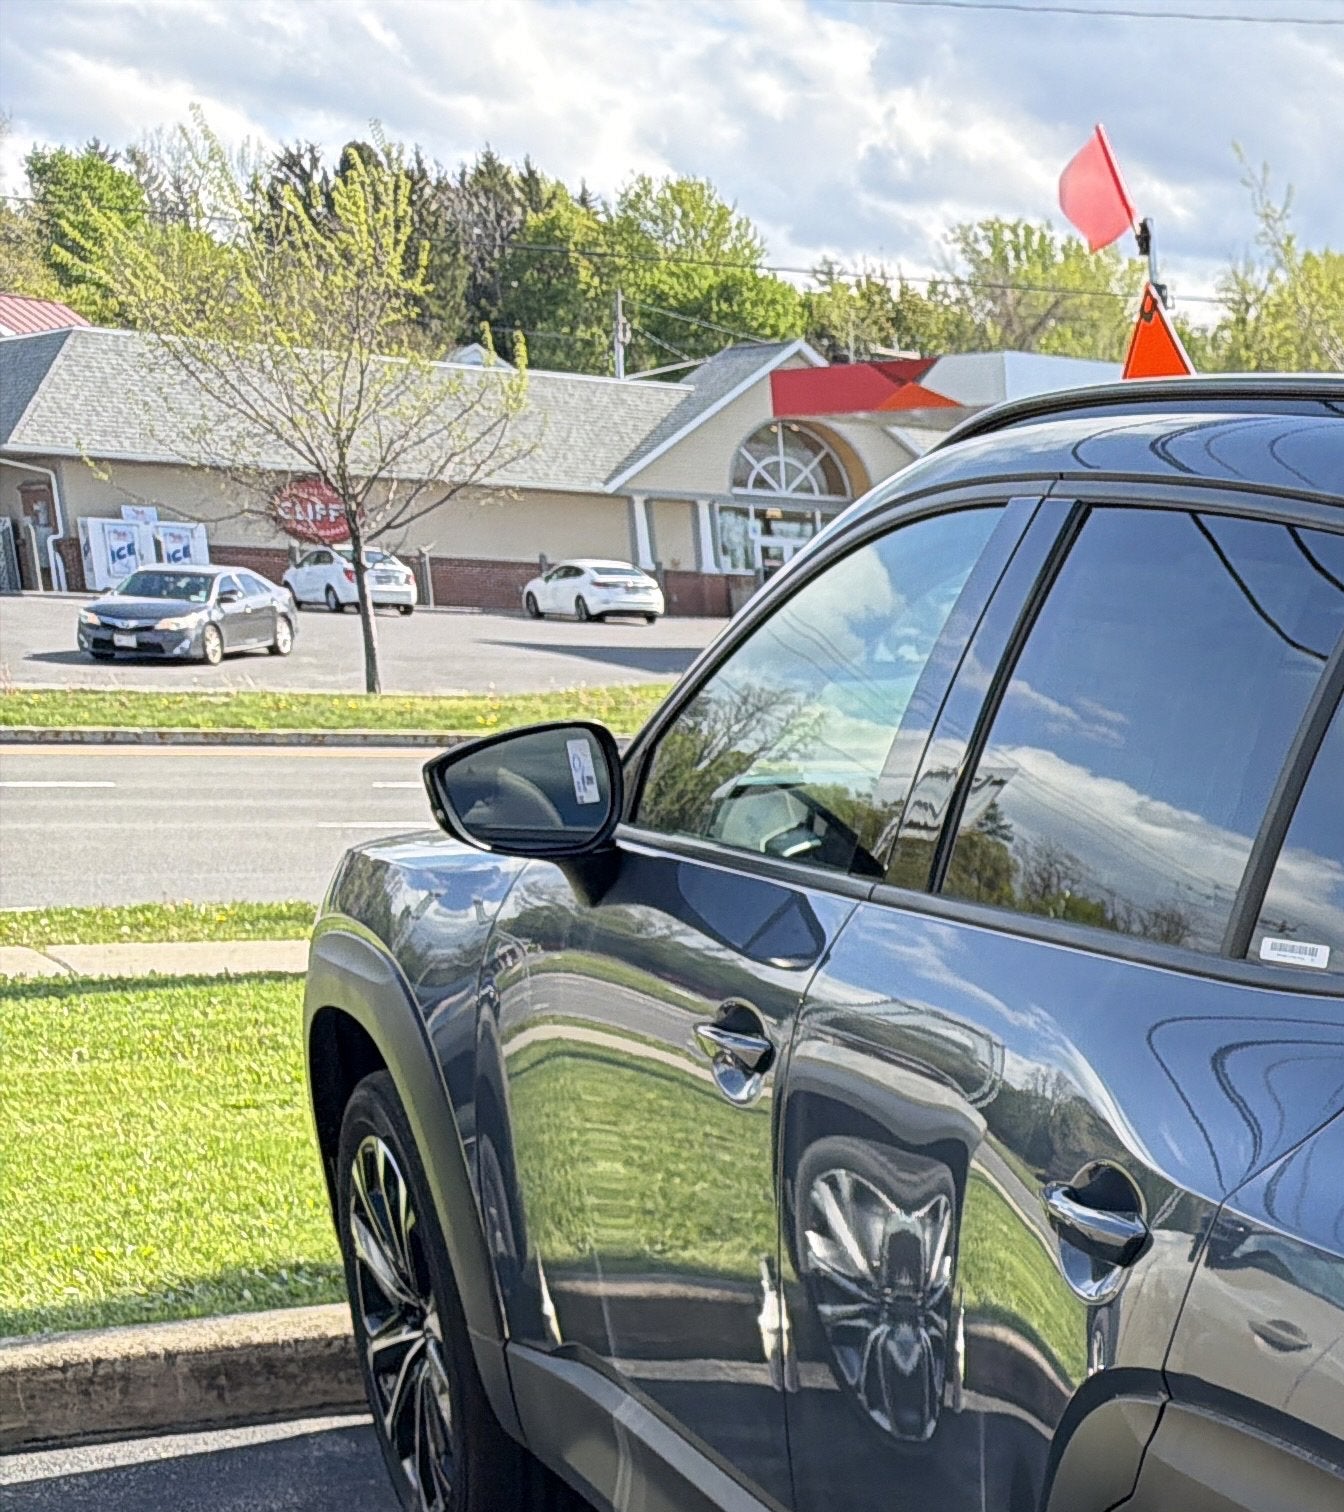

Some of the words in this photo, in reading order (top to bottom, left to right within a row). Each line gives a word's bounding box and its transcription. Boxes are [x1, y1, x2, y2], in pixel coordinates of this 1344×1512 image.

[278, 500, 347, 522] CLIFF
[110, 542, 136, 565] ICE
[167, 544, 192, 564] ICE
